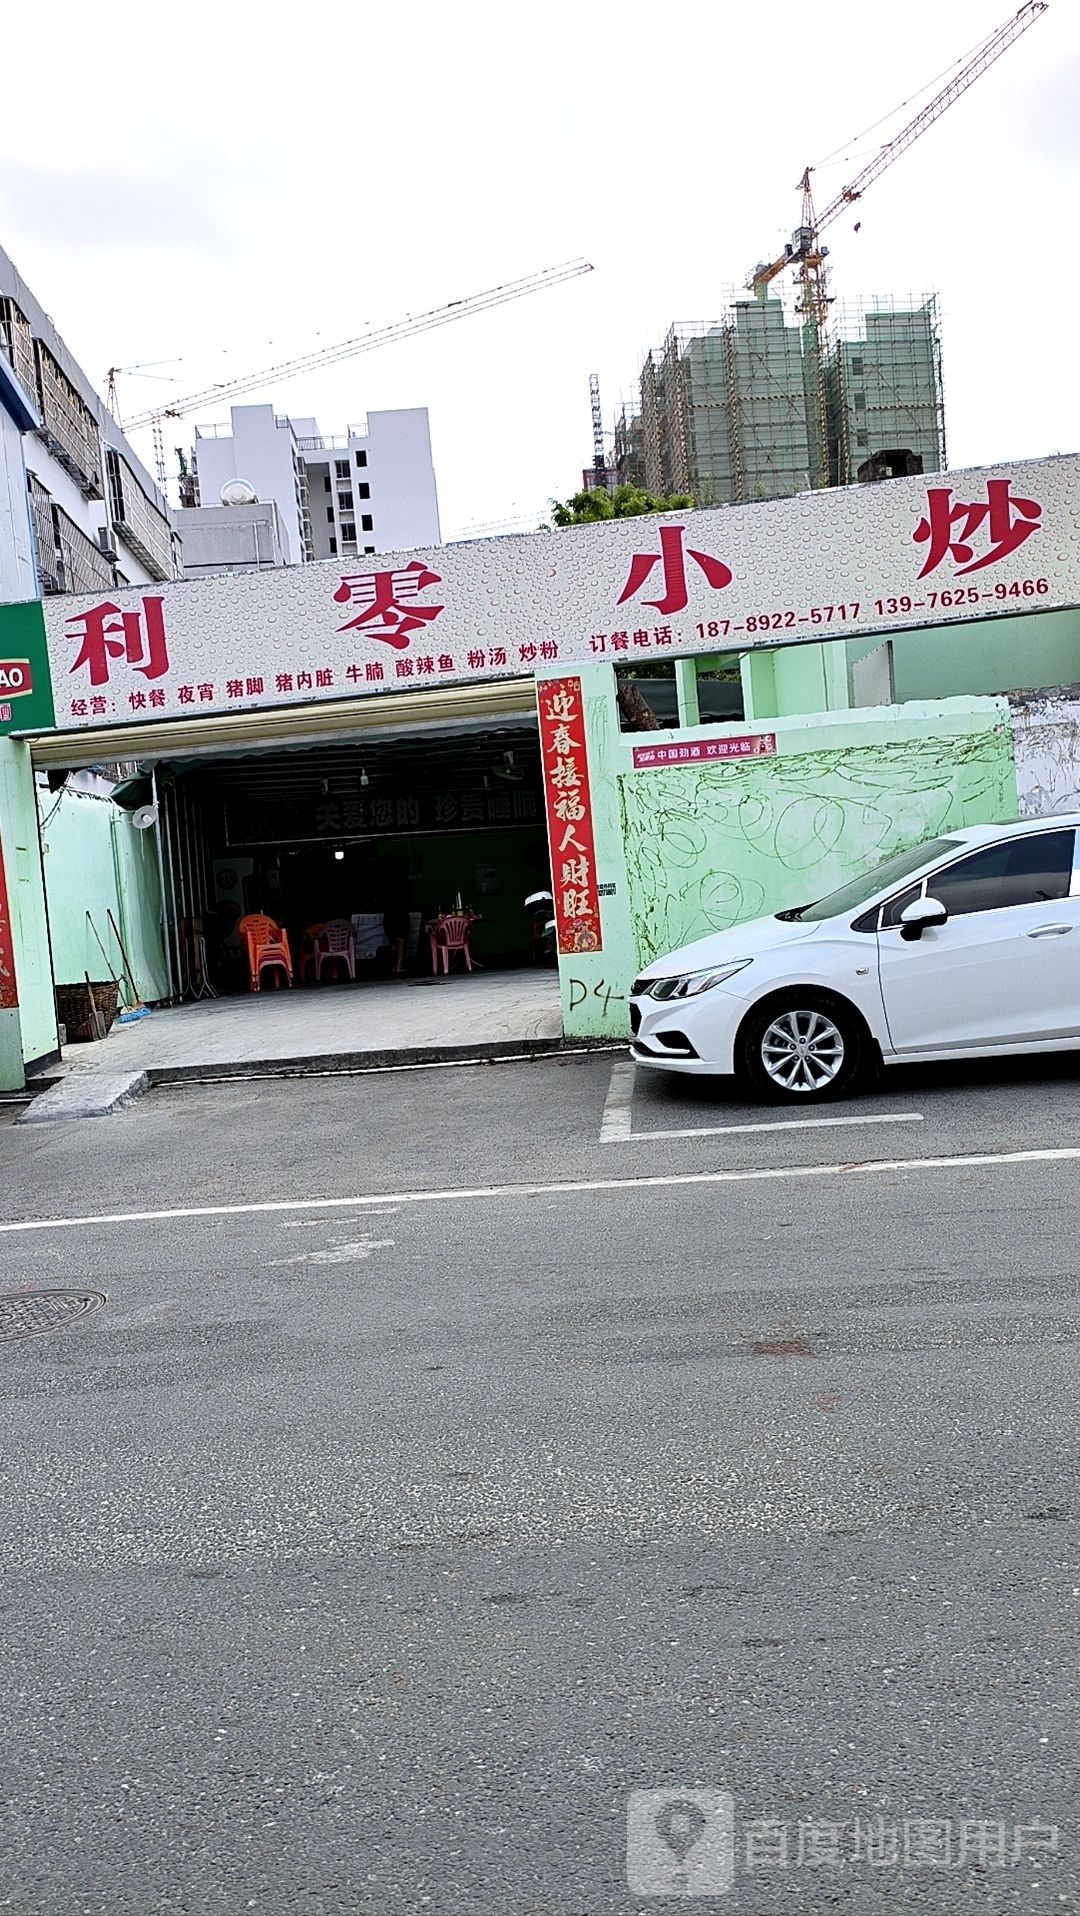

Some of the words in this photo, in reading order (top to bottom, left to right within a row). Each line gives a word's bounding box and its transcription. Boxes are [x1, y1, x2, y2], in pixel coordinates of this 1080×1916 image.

[64, 480, 1042, 687] 利零小炒
[696, 602, 860, 639] 187-8922-5717
[874, 578, 1049, 616] 139-7625-9466
[129, 689, 166, 710] 快餐
[178, 683, 214, 704] 夜宵
[226, 676, 264, 699] 猪脚
[275, 669, 334, 693] 猪内脏
[346, 662, 384, 684] 牛腩
[395, 653, 455, 678] 酸辣鱼
[467, 647, 507, 669] 粉汤
[519, 640, 558, 662] 炒粉
[657, 746, 700, 761] 中国劲酒
[706, 741, 751, 756] 欢迎光临
